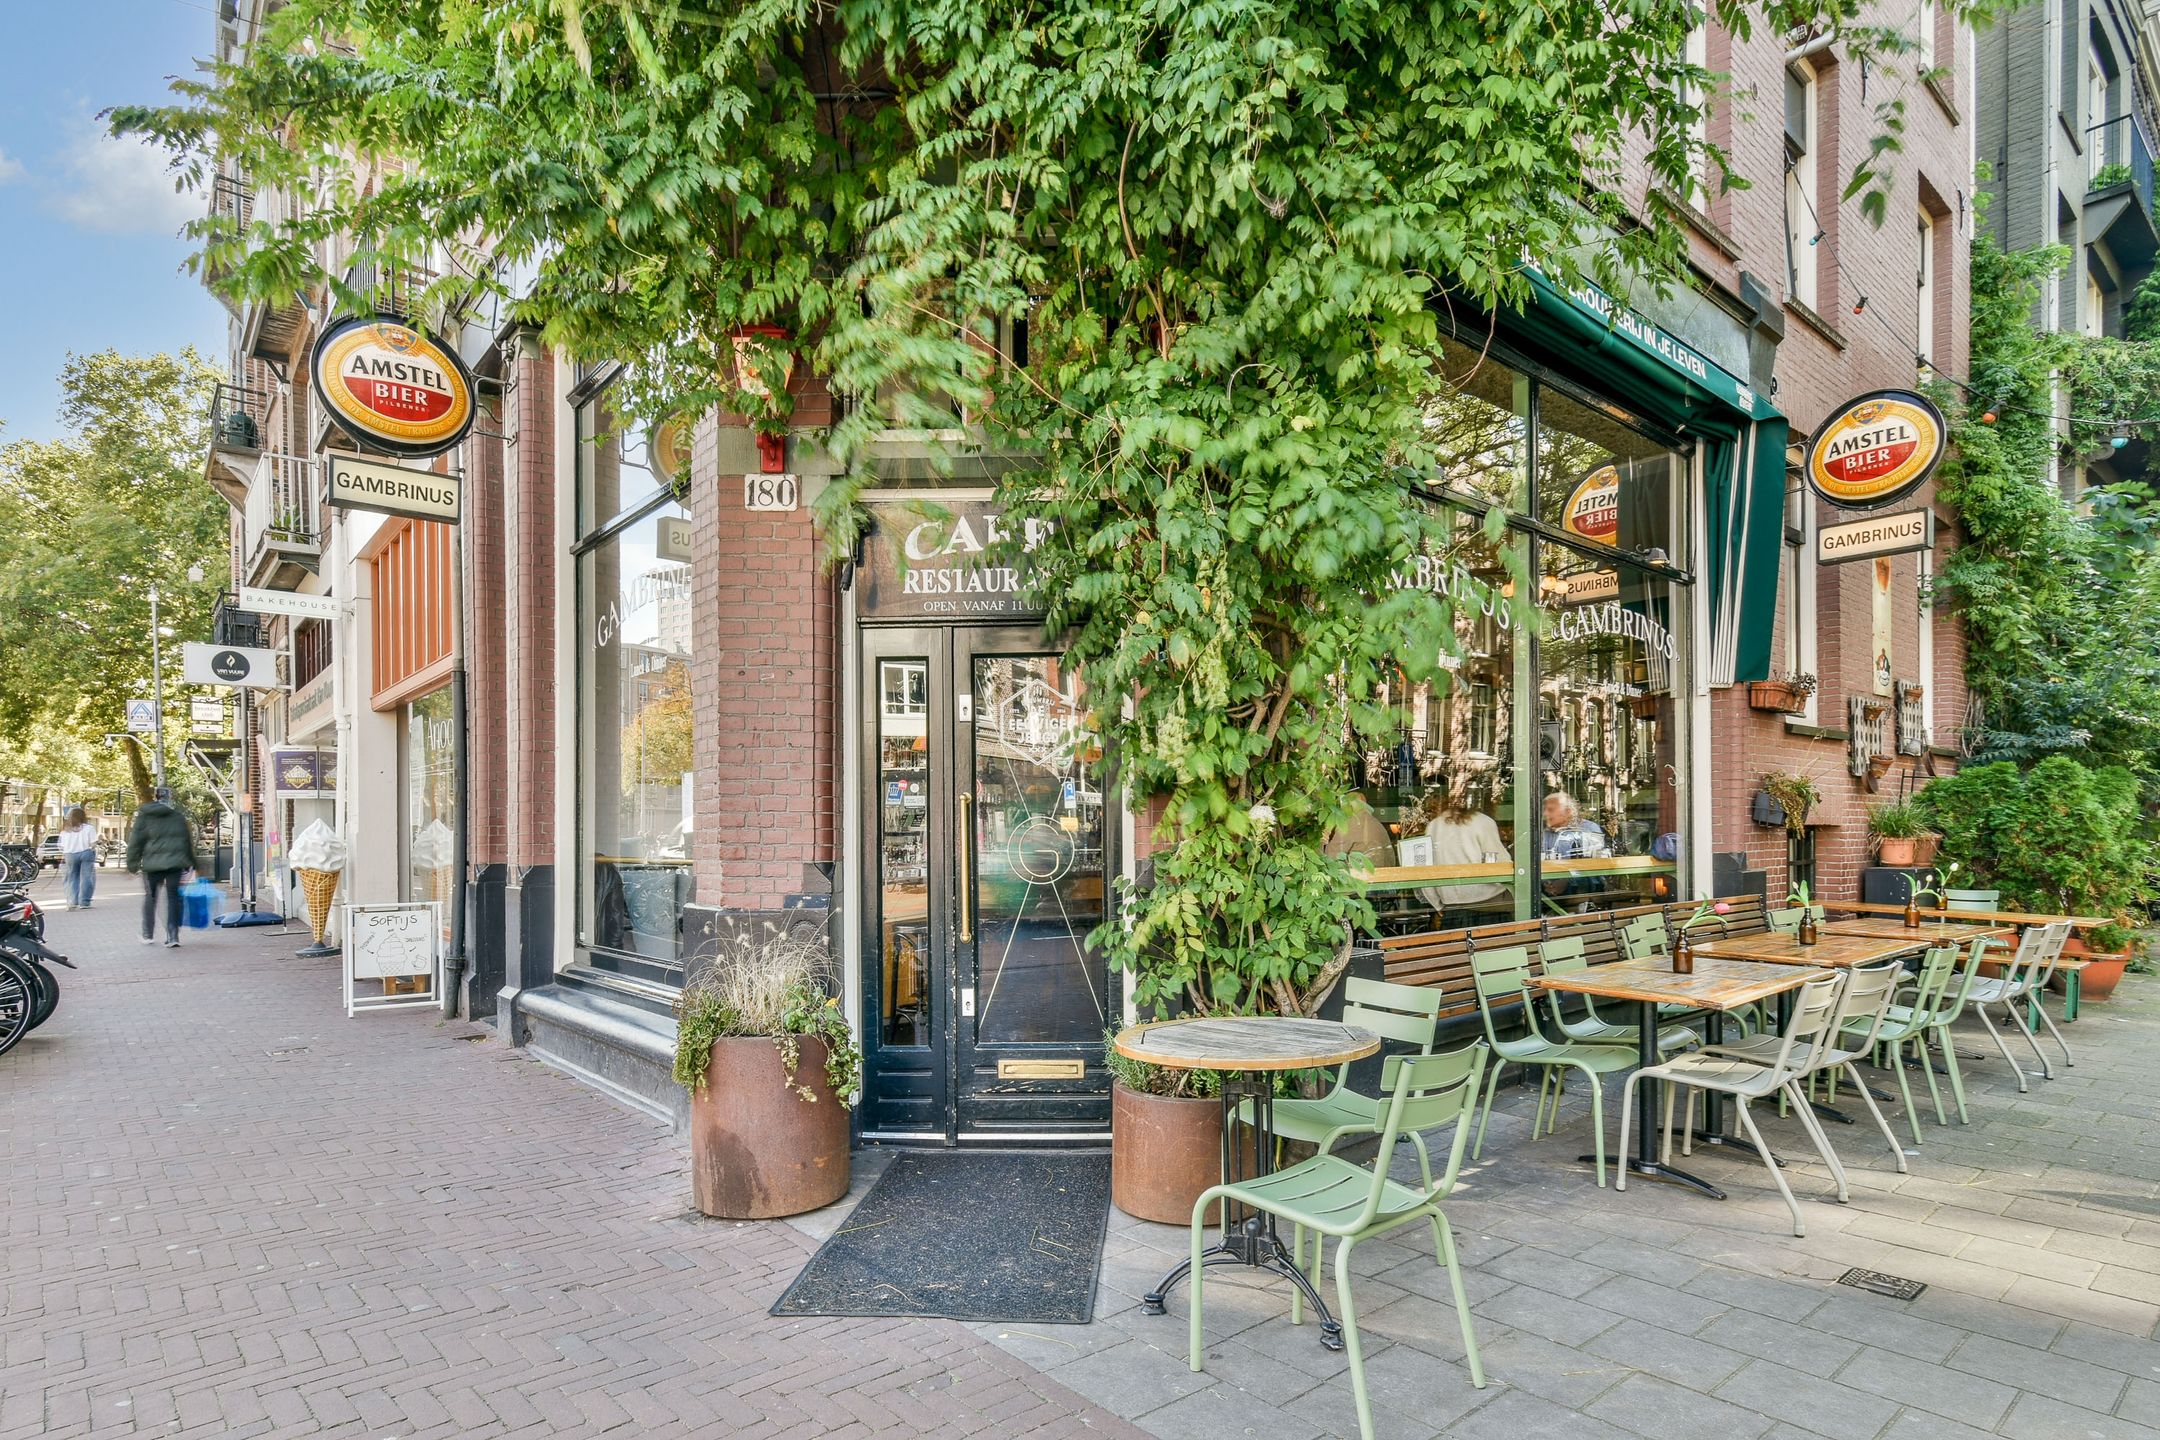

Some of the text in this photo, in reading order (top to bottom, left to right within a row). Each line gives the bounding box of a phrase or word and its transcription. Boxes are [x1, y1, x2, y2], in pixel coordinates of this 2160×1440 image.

[1644, 327, 1657, 348] IN
[1658, 335, 1672, 360] JE
[1673, 347, 1707, 380] LEVEN
[351, 354, 447, 392] AMSTEL
[375, 382, 429, 407] BIER
[1828, 425, 1910, 459] AMSTEL
[1845, 448, 1891, 470] BIER
[336, 471, 455, 506] GAMBRINUS
[746, 479, 795, 507] 180
[1823, 521, 1923, 550] GAMBRINUS
[902, 567, 1041, 594] RESTAURA
[246, 594, 338, 612] BAKEHOUSE
[923, 601, 957, 611] OPEN
[964, 600, 1005, 611] VANAF
[1012, 601, 1022, 610] 11
[369, 914, 418, 931] SOFTIJS
